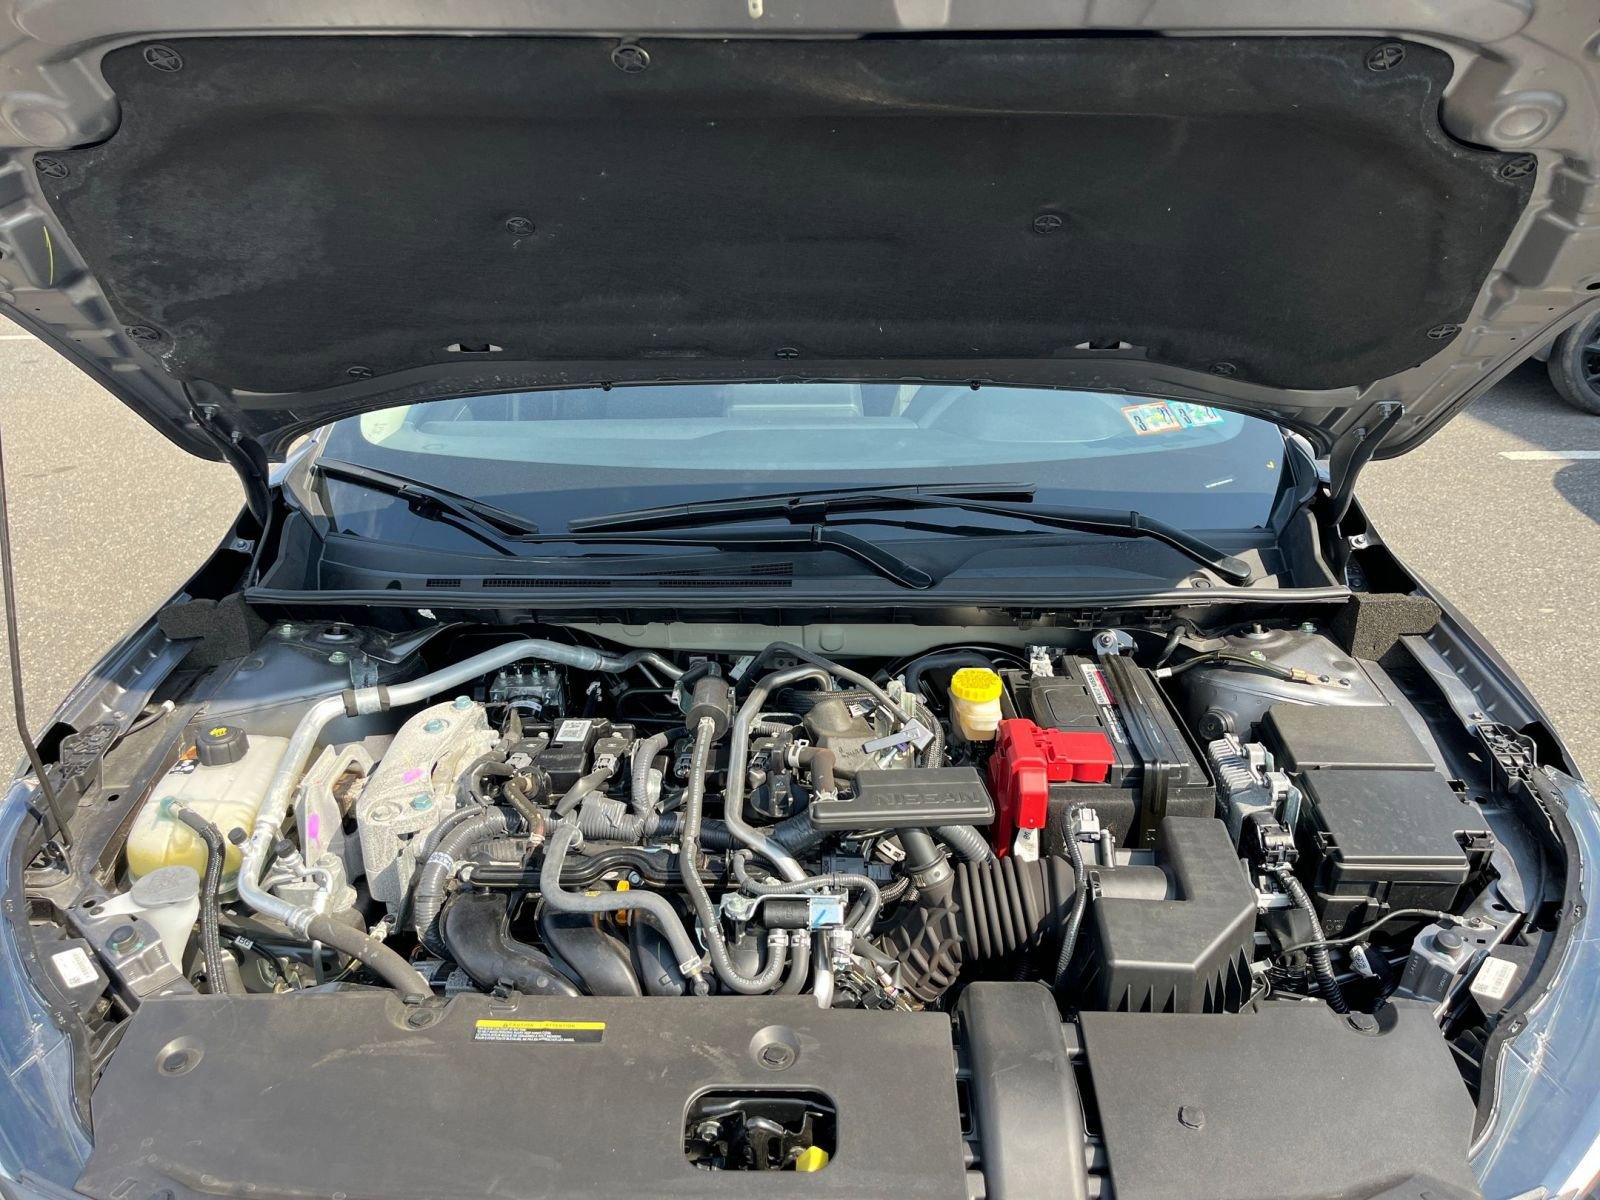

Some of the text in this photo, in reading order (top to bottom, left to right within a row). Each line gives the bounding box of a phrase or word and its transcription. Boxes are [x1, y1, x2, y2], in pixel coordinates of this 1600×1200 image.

[1134, 406, 1176, 431] 3 21
[1179, 408, 1193, 424] 3
[872, 791, 981, 806] NISSAN
